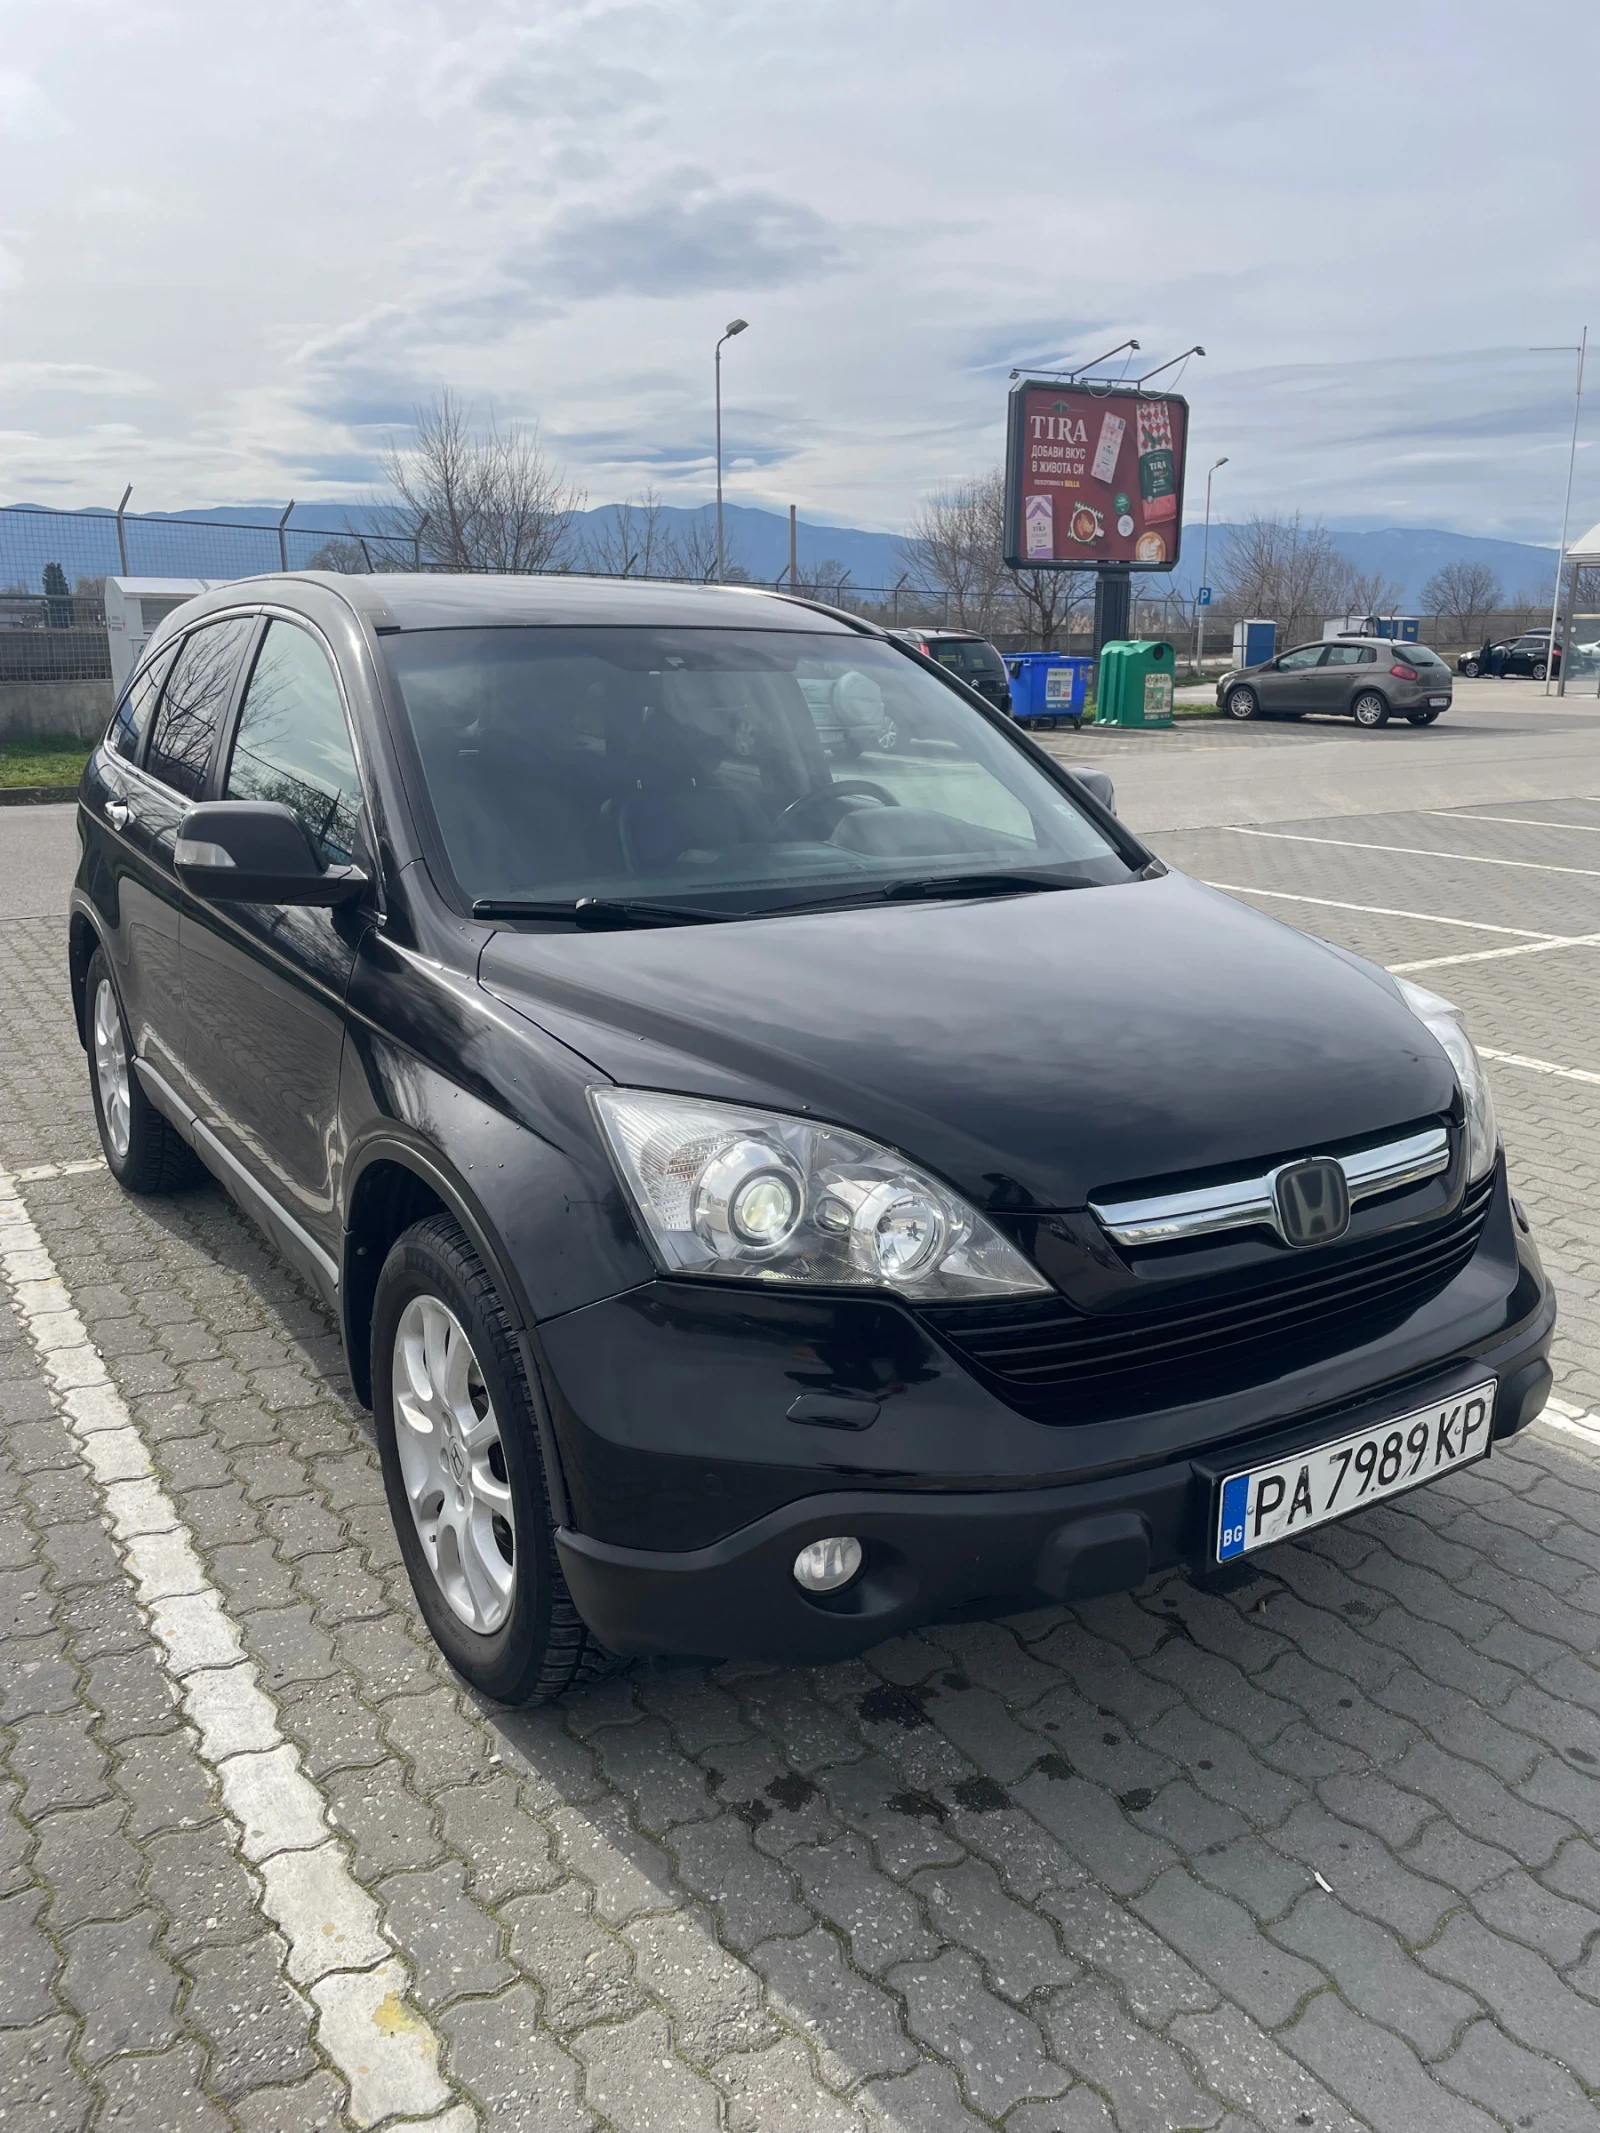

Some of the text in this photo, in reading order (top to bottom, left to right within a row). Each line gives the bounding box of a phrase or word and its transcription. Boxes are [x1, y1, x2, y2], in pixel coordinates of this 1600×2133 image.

[1030, 415, 1089, 444] TIRA
[1031, 445, 1086, 460] ДОБАВИ ВКУС
[1039, 461, 1072, 474] ЖИВОТА
[1073, 463, 1085, 475] СИ
[1149, 460, 1167, 471] TIRA
[1200, 589, 1209, 604] P
[1253, 1397, 1486, 1537] PA 7989 KP
[1223, 1525, 1243, 1548] BG
